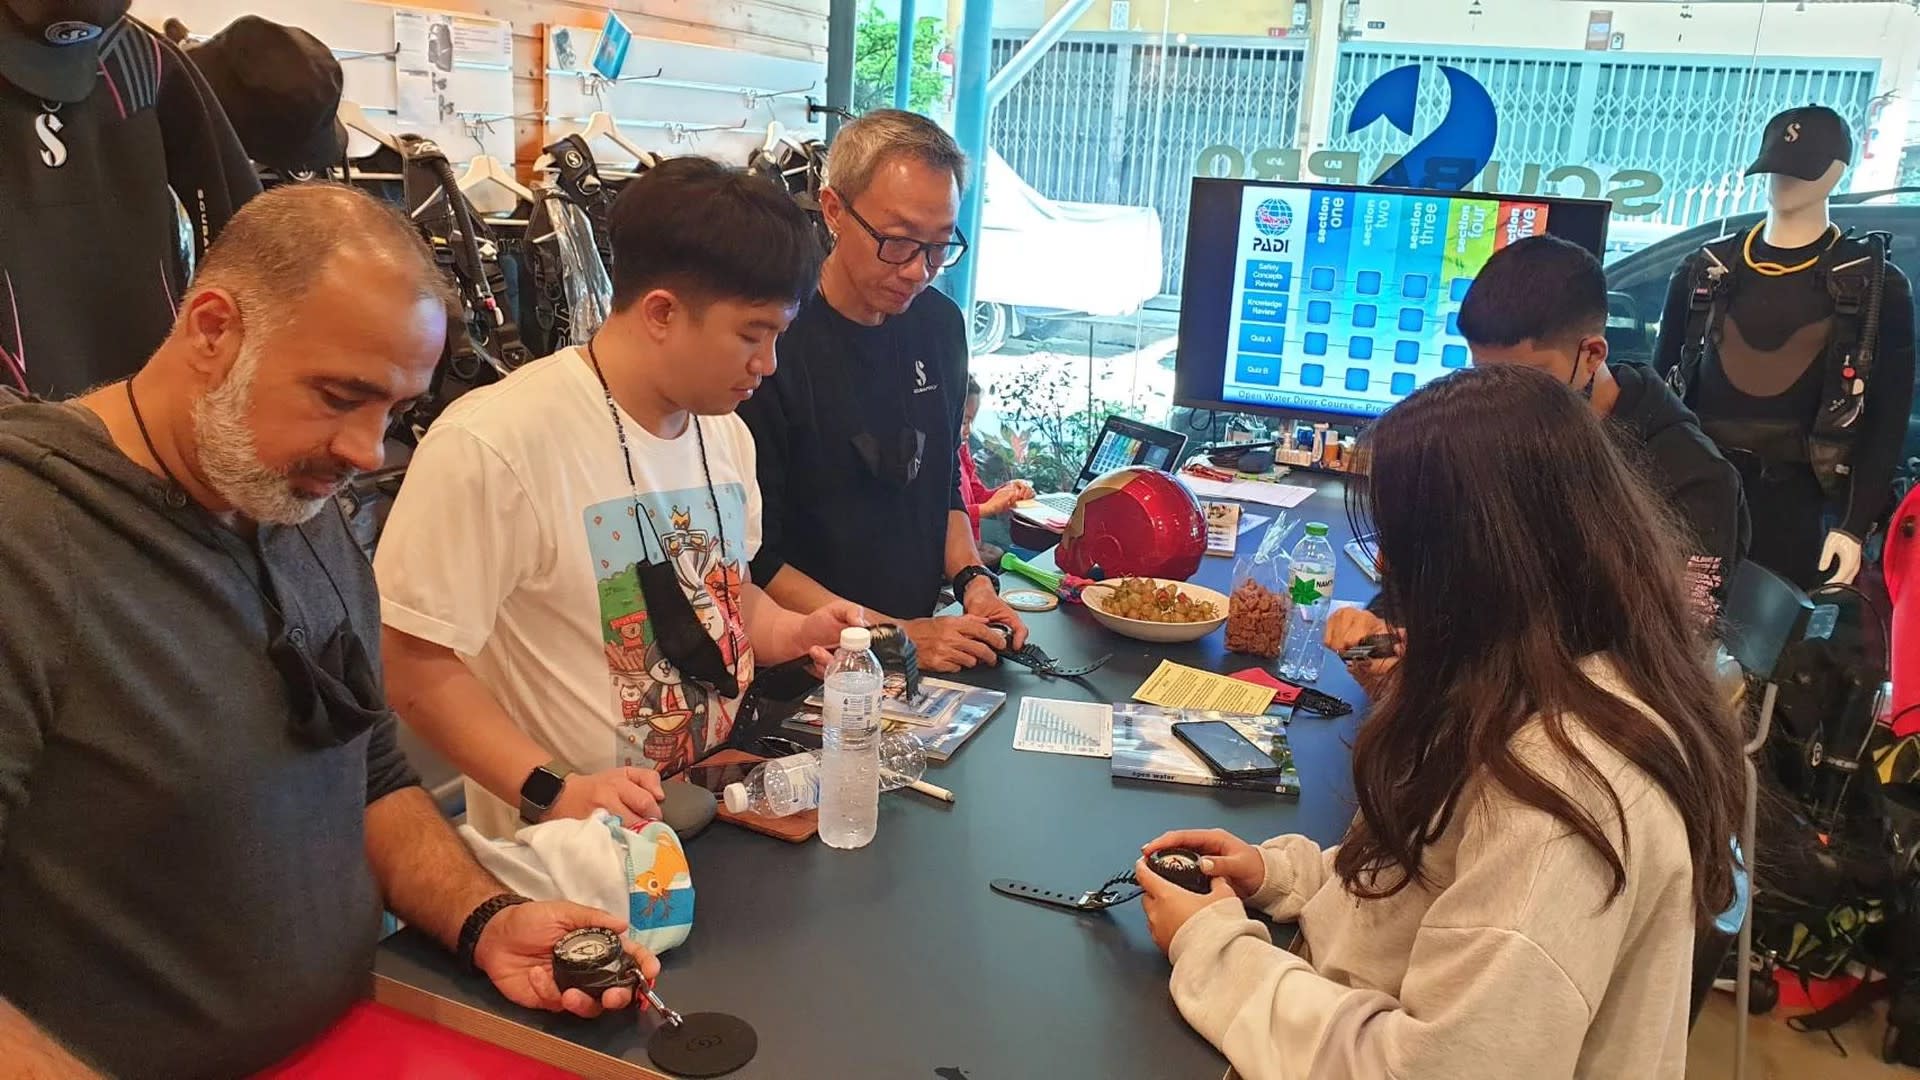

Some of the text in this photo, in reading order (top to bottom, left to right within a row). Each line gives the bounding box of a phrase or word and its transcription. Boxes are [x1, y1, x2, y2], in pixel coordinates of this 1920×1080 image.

[1317, 196, 1330, 244] section
[1330, 197, 1344, 229] one
[1363, 199, 1376, 247] section
[1375, 199, 1391, 229] two
[1468, 205, 1487, 238] four
[1409, 202, 1423, 250] section
[1419, 202, 1438, 246] three
[1457, 205, 1470, 253] section
[1253, 237, 1290, 253] PADI
[1252, 271, 1284, 281] Concepts
[1258, 263, 1279, 273] Safety
[1254, 280, 1279, 289] Review
[1247, 299, 1283, 308] Knowledge
[1252, 306, 1277, 316] Review
[1250, 334, 1265, 343] Quiz
[1247, 366, 1262, 374] Quiz
[1238, 390, 1262, 401] Open
[1265, 392, 1290, 403] Water
[1293, 395, 1317, 406] Diver
[1320, 398, 1353, 410] Course
